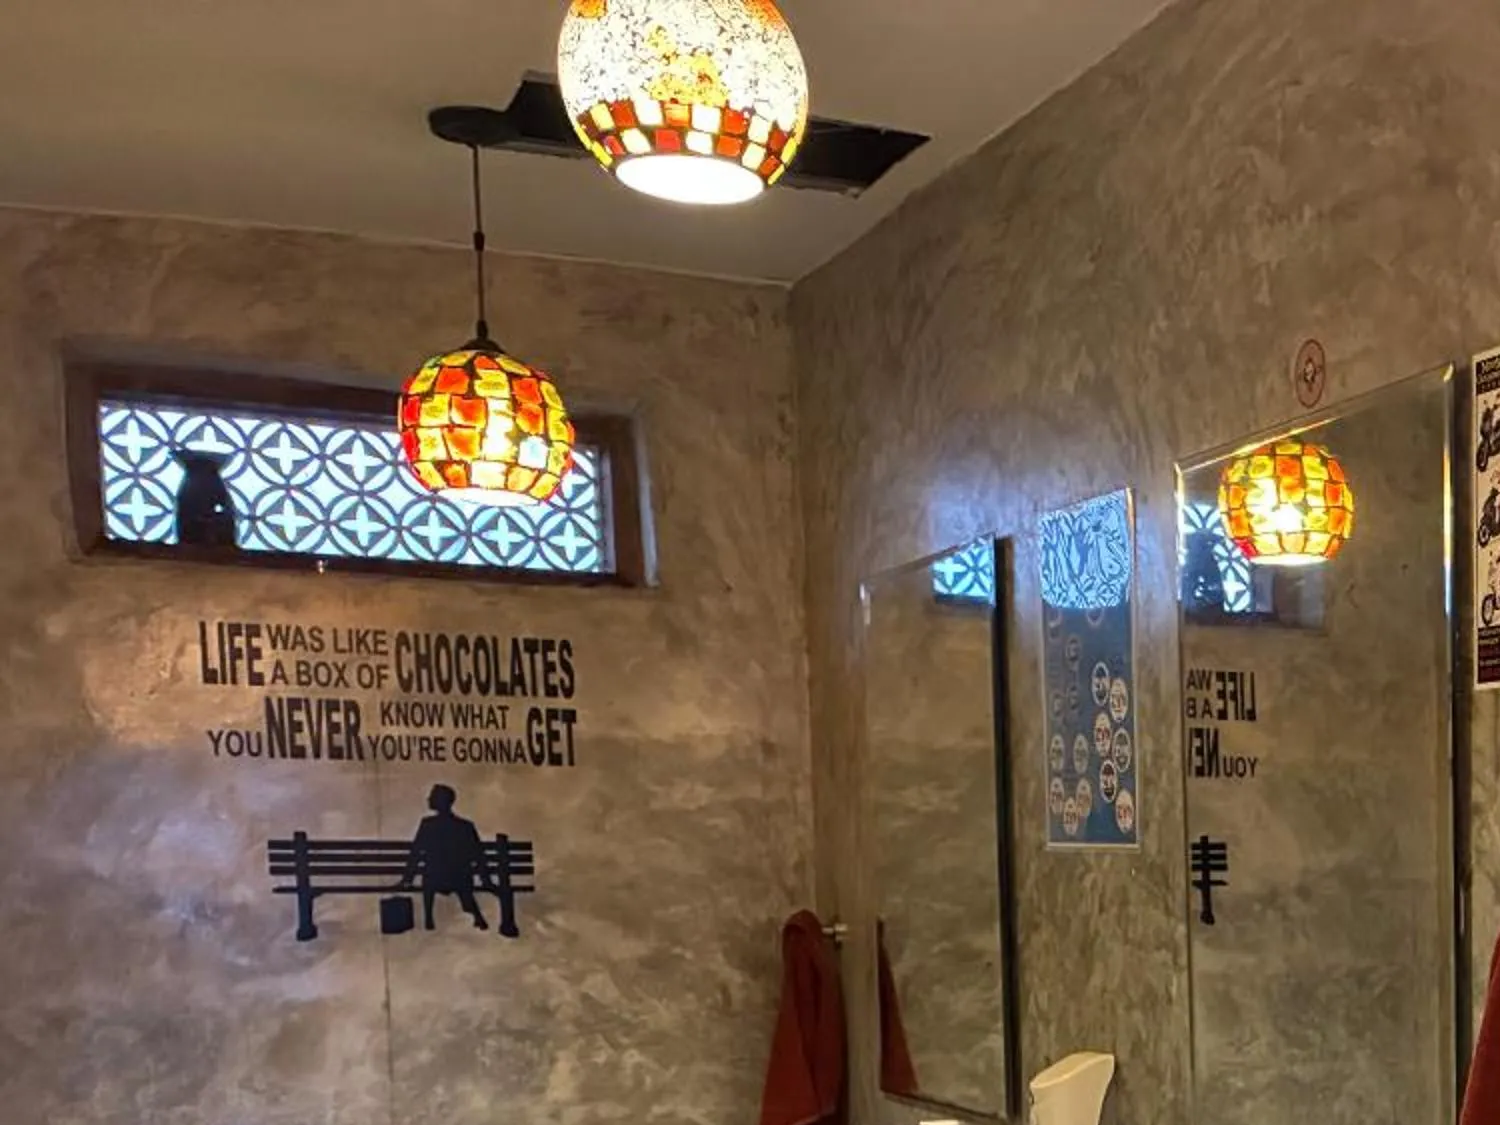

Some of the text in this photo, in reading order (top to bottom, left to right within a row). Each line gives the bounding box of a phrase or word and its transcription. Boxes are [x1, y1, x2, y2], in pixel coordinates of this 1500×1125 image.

[200, 620, 389, 686] LIFE WAS LIKE
[271, 630, 575, 699] A BOX OF CHOCOLATES
[207, 696, 510, 761] YOU NEVER KNOW WHAT
[368, 706, 577, 767] YOU'RE GONNA GET
